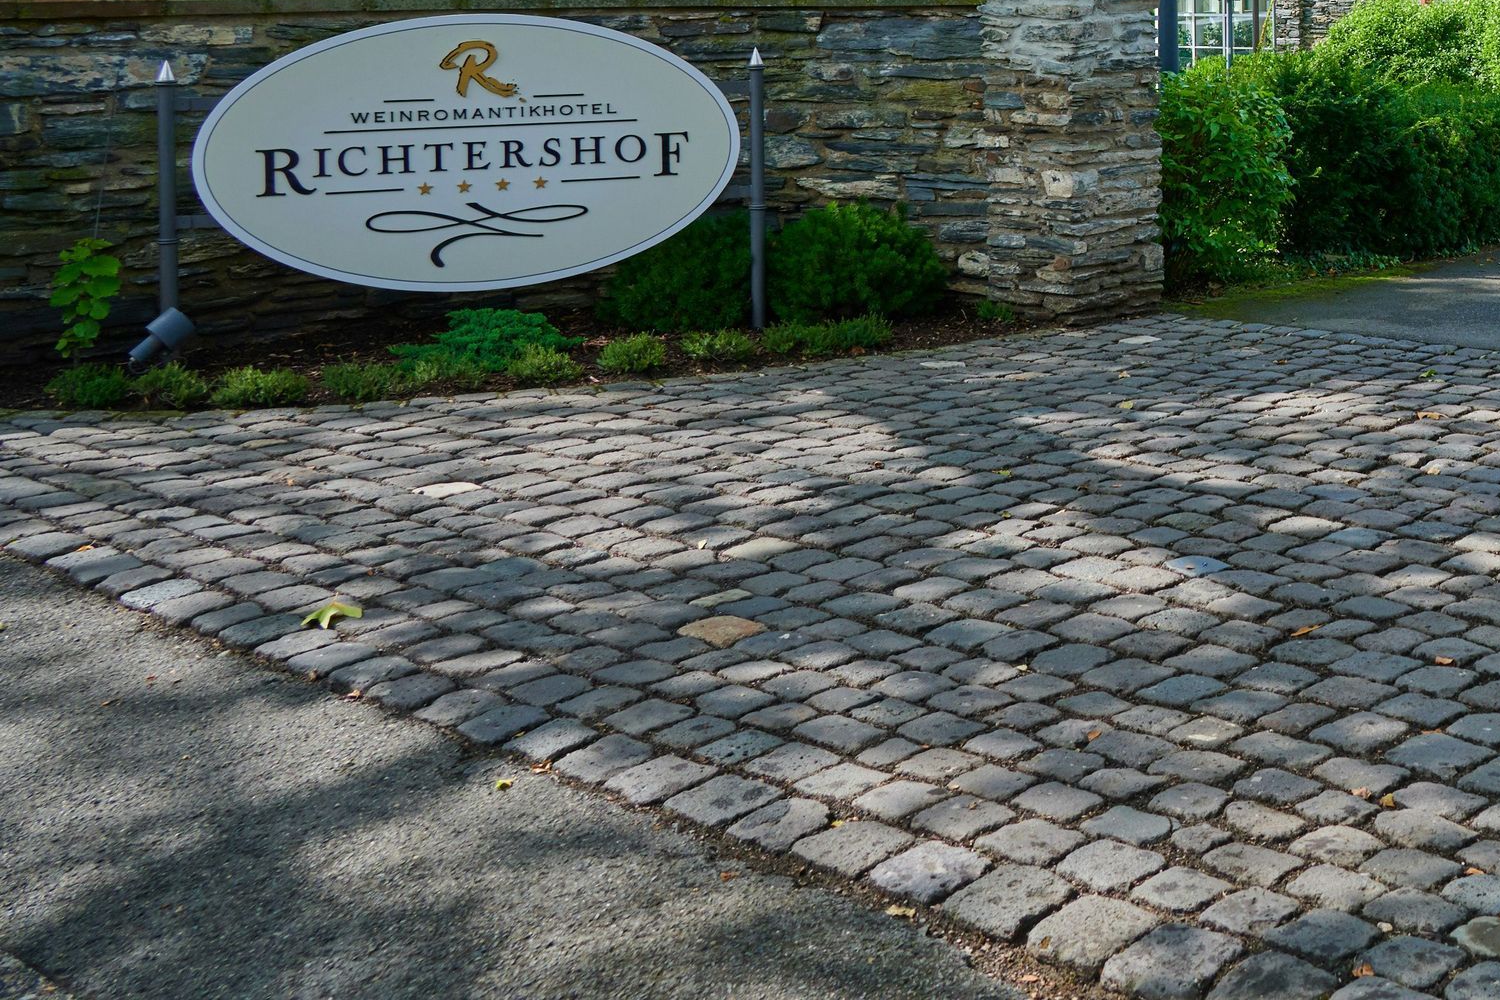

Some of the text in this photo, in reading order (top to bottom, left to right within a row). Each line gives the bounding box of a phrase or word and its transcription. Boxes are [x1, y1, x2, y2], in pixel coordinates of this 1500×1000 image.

[439, 40, 521, 99] R
[350, 102, 618, 124] WEINROMANTIKHOTEL
[255, 130, 690, 198] RICHTERSHOF
